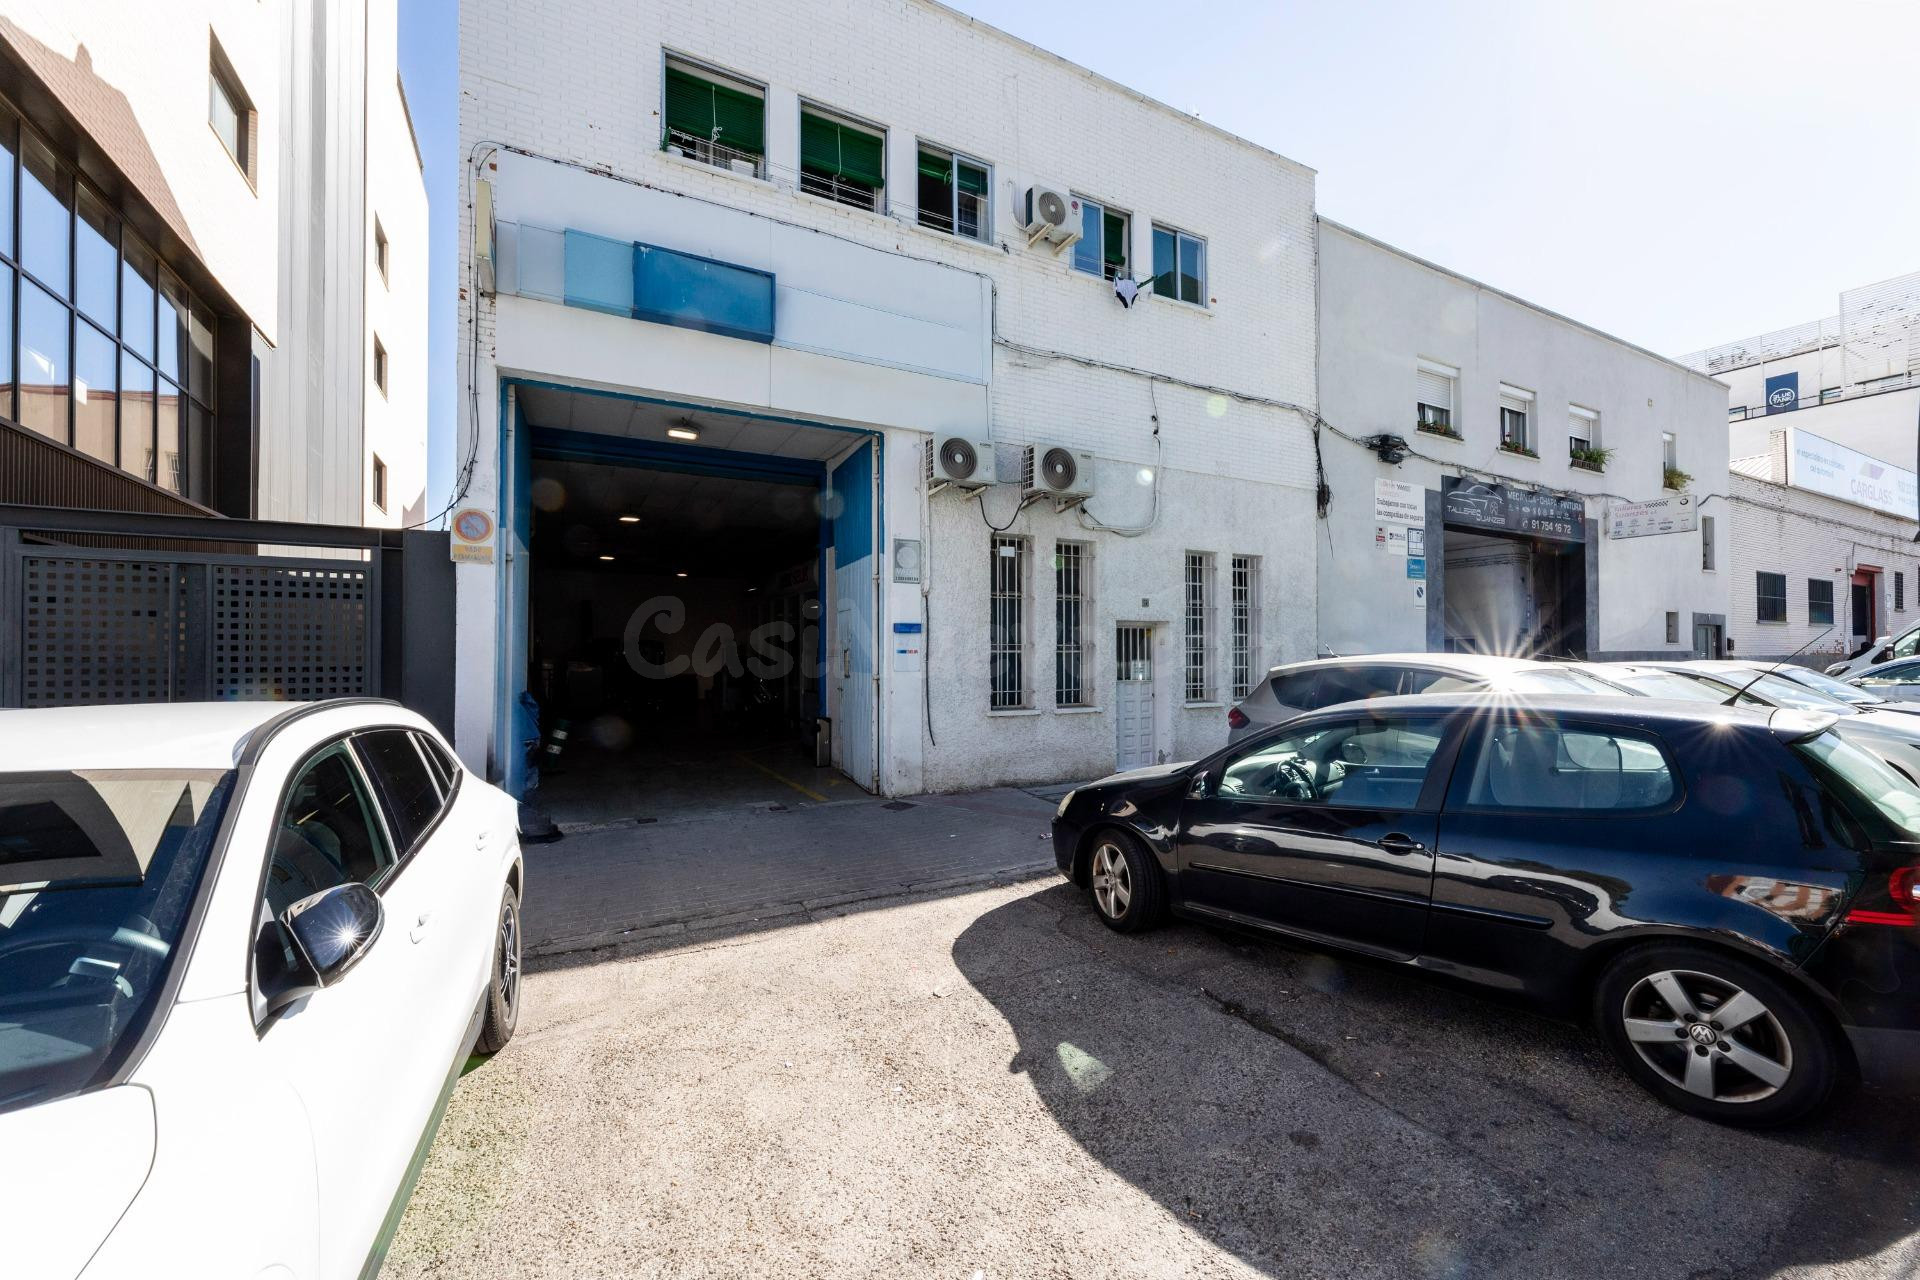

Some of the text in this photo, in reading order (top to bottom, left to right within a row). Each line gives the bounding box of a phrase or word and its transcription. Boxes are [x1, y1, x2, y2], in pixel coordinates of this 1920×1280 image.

[1850, 479, 1893, 505] CARGLASS
[1531, 519, 1572, 534] 91 754 16 72
